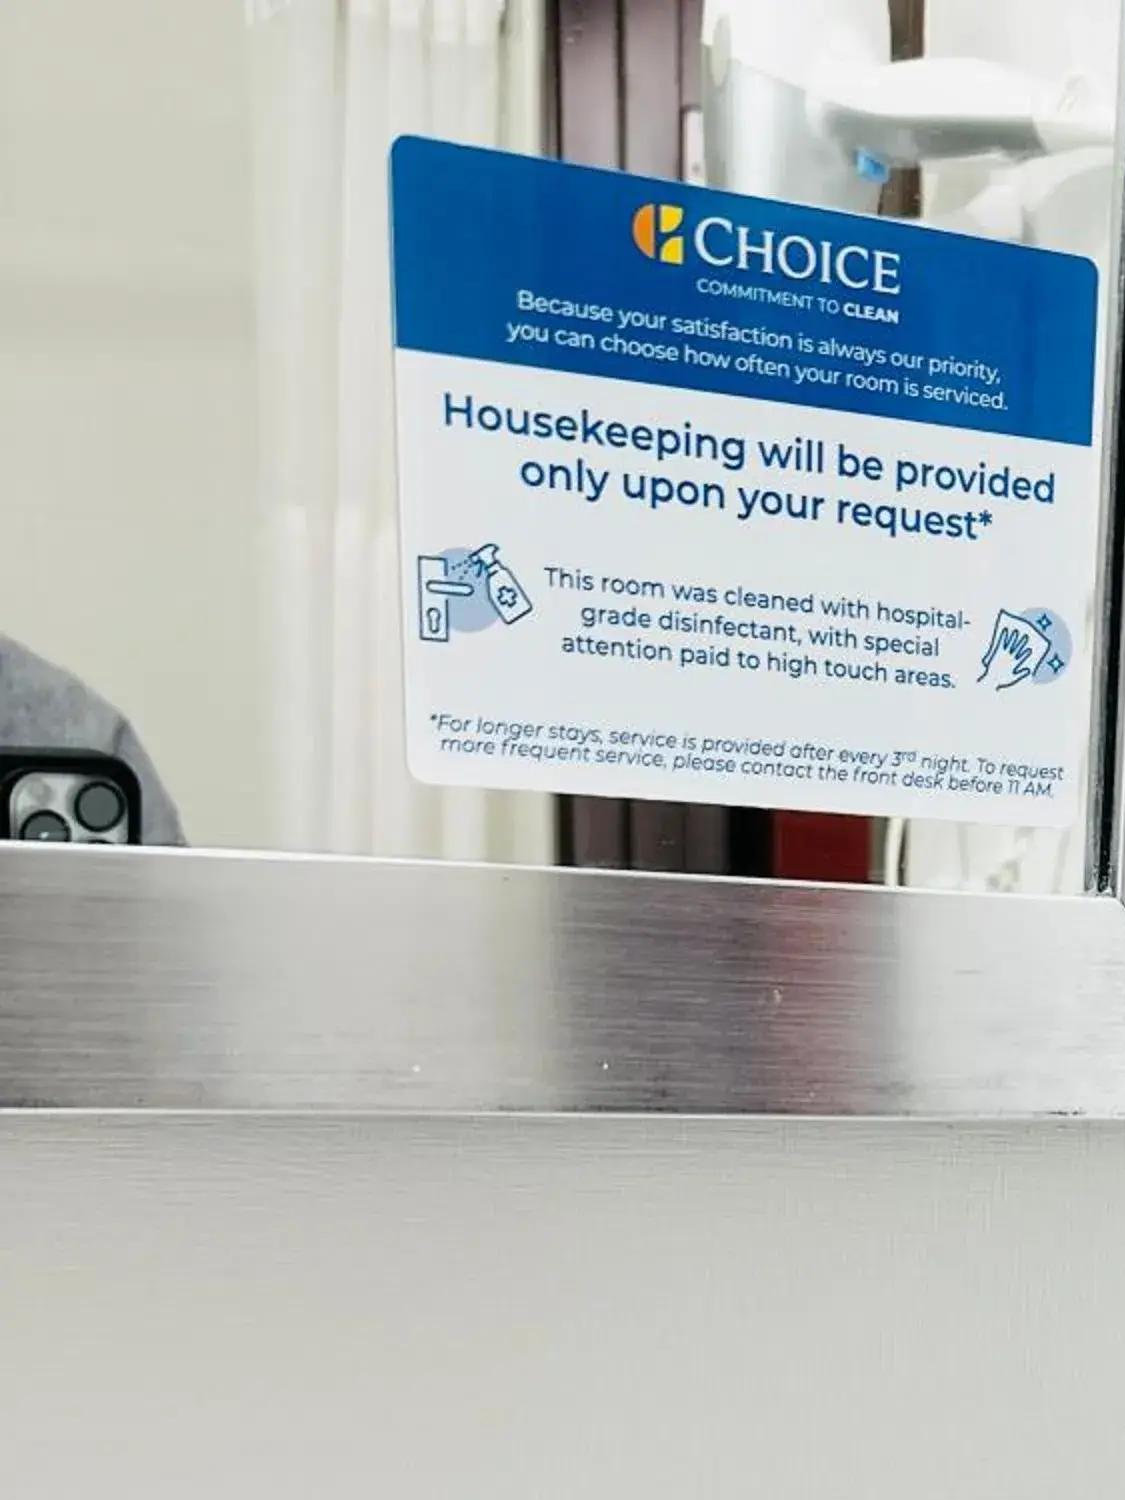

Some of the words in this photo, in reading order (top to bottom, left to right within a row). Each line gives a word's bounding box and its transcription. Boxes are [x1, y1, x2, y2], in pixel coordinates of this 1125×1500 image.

[694, 216, 901, 294] CHOICE
[695, 277, 813, 310] COMMITMENT
[818, 297, 840, 314] TO
[842, 302, 899, 325] CLEAN
[505, 322, 549, 343] you
[554, 328, 595, 350] can
[600, 333, 679, 362] choose
[684, 344, 731, 369] how
[735, 353, 790, 379] often
[794, 364, 841, 385] your
[846, 373, 899, 395] room
[904, 377, 919, 397] is
[922, 384, 1009, 411] serviced.
[516, 289, 613, 322] Because
[617, 308, 666, 329] your
[671, 317, 793, 350] satisfaction
[799, 333, 814, 353] is
[817, 336, 887, 367] always
[890, 352, 924, 369] our
[928, 356, 1001, 385] priority,
[444, 391, 746, 471] Housekeeping
[757, 436, 824, 473] will
[837, 443, 883, 480] be
[896, 460, 1056, 504] provided
[520, 458, 609, 502] only
[623, 472, 725, 509] upon
[737, 484, 825, 520] your
[544, 566, 595, 592] This
[601, 576, 665, 599] room
[671, 584, 718, 604] was
[724, 586, 814, 614] cleaned
[821, 597, 870, 620] with
[876, 602, 972, 630] hospital-
[561, 634, 673, 662] attention
[680, 645, 731, 668] paid
[737, 651, 761, 671] to
[766, 651, 818, 679] high
[824, 659, 887, 684] touch
[894, 667, 957, 690] areas.
[580, 606, 652, 629] grade
[658, 610, 803, 647] disinfectant,
[807, 626, 858, 650] with
[863, 635, 940, 657] special
[440, 736, 496, 756] more
[500, 737, 592, 763] frequent
[594, 746, 667, 771] service,
[672, 752, 736, 775] please
[740, 760, 813, 780] contact
[817, 763, 849, 783] the
[852, 765, 898, 788] front
[901, 769, 945, 792] desk
[947, 775, 1004, 796] before
[1006, 779, 1020, 796] 11
[476, 716, 544, 741] longer
[549, 724, 603, 745] stays,
[608, 728, 678, 750] service
[682, 732, 698, 751] is
[701, 736, 787, 758] provided
[790, 743, 835, 763] after
[838, 749, 888, 770] every
[976, 756, 998, 776] To
[999, 763, 1065, 783] request
